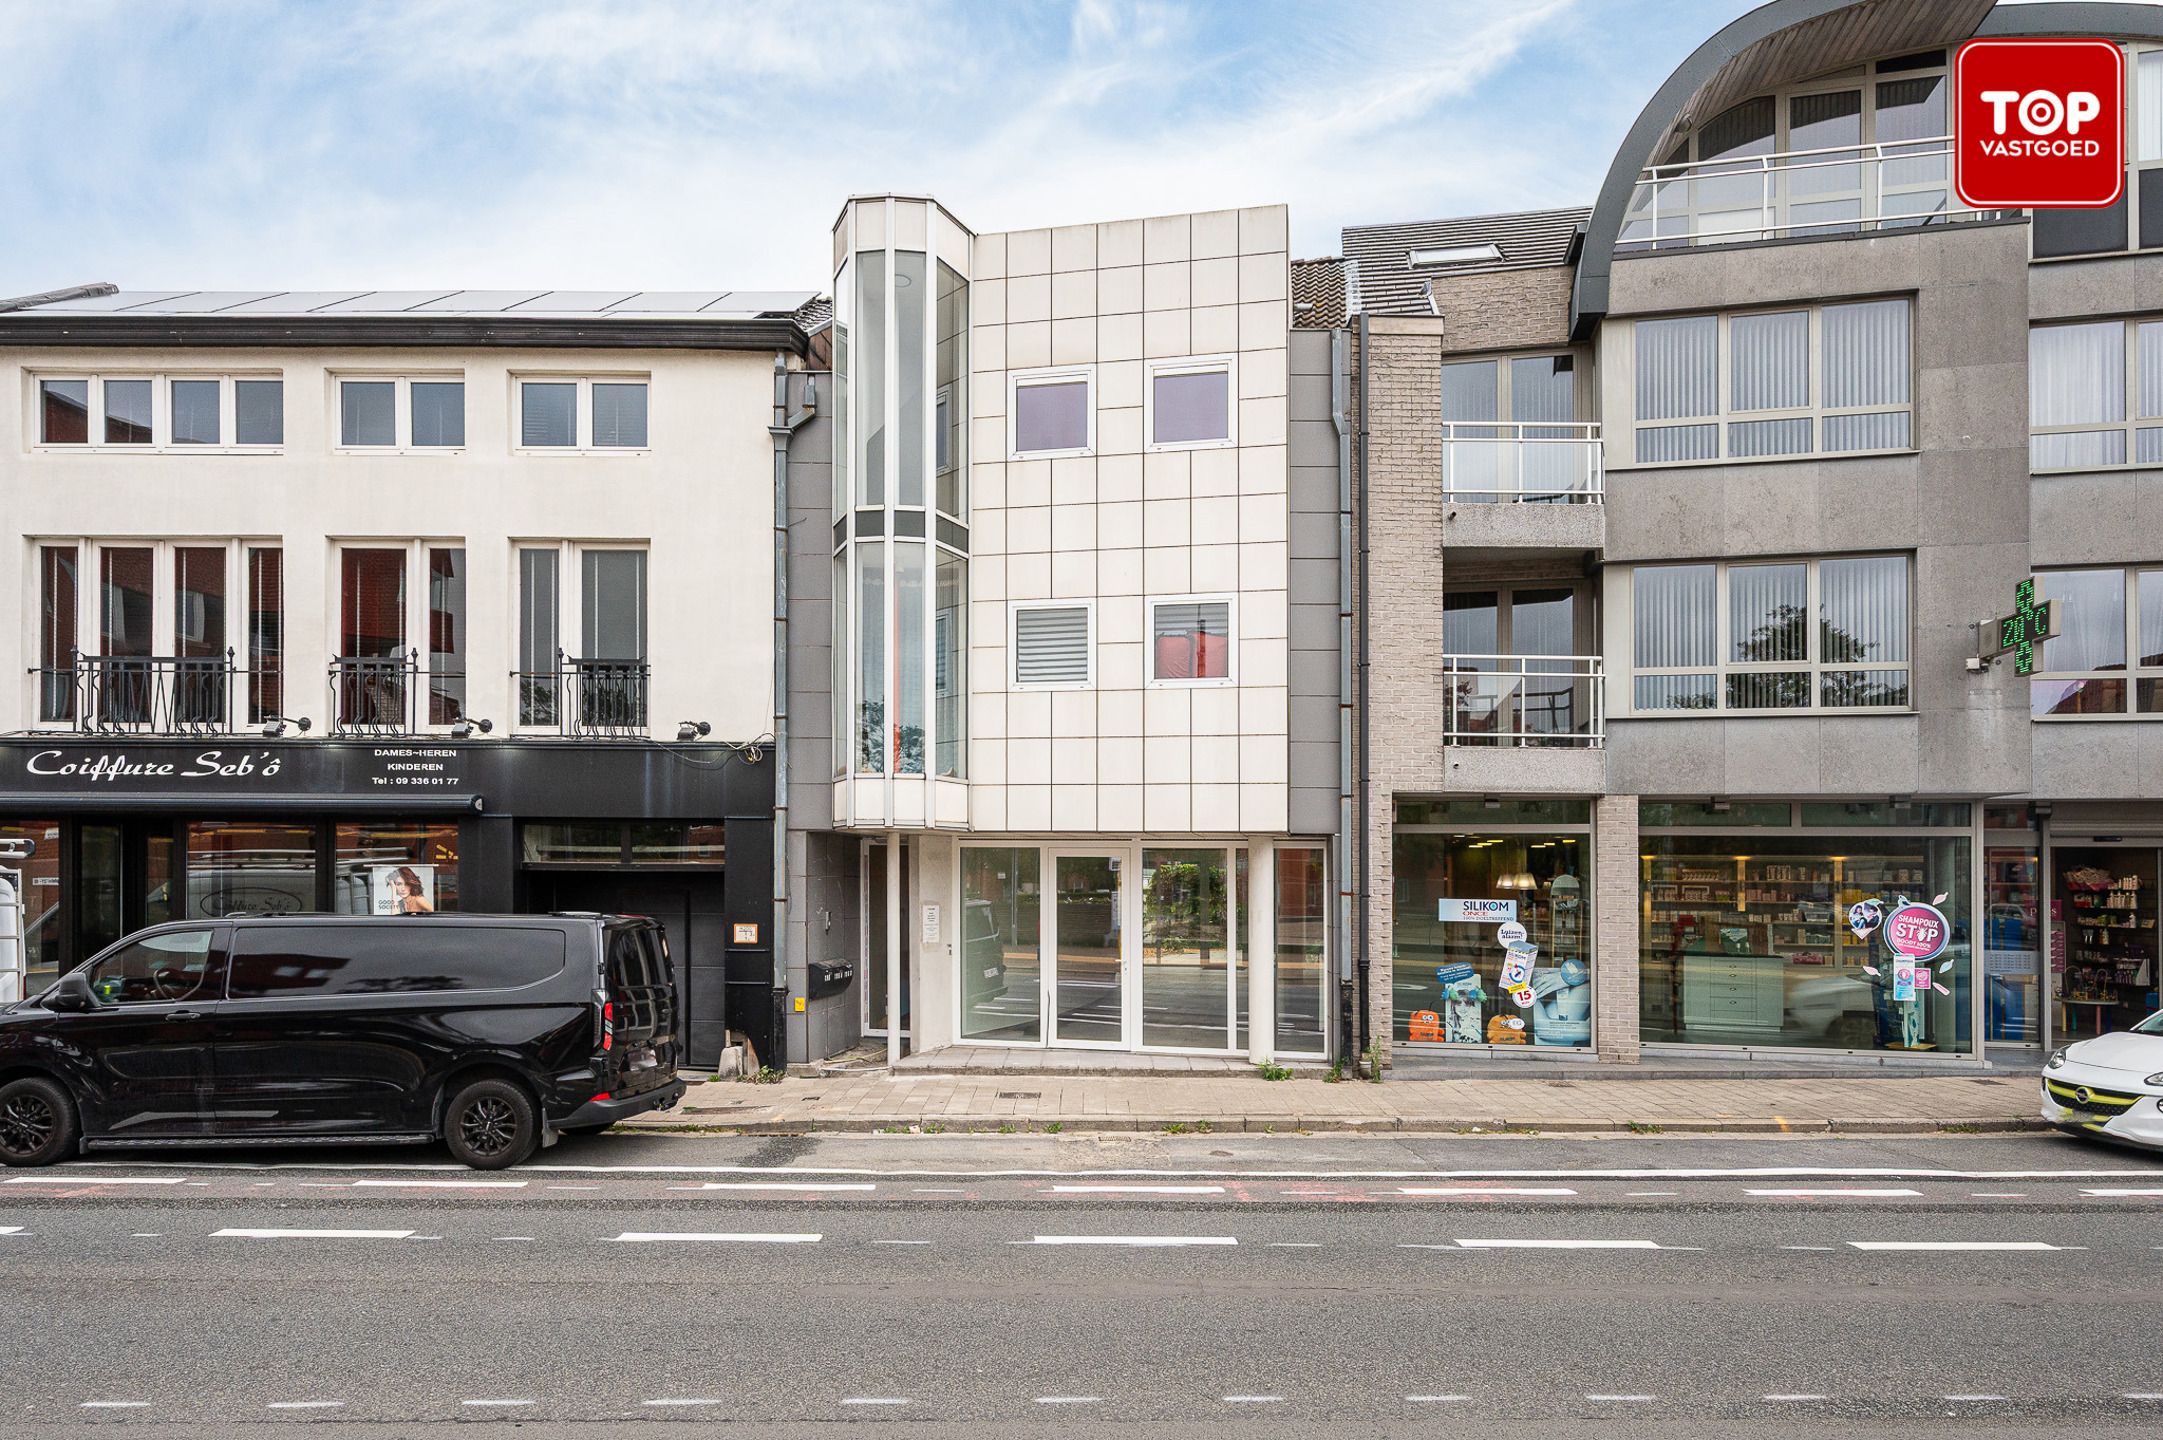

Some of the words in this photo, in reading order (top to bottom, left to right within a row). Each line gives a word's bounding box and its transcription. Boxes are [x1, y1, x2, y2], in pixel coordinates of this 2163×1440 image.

[26, 750, 174, 781] Coiffure
[387, 763, 444, 771] KINDEREN
[396, 777, 408, 785] 09
[411, 777, 430, 785] 336
[431, 777, 443, 785] 01
[446, 777, 459, 785] 77
[1463, 901, 1509, 911] SILIKOM
[1898, 914, 1940, 929] SHAMPOUX
[1517, 990, 1532, 1001] 15
